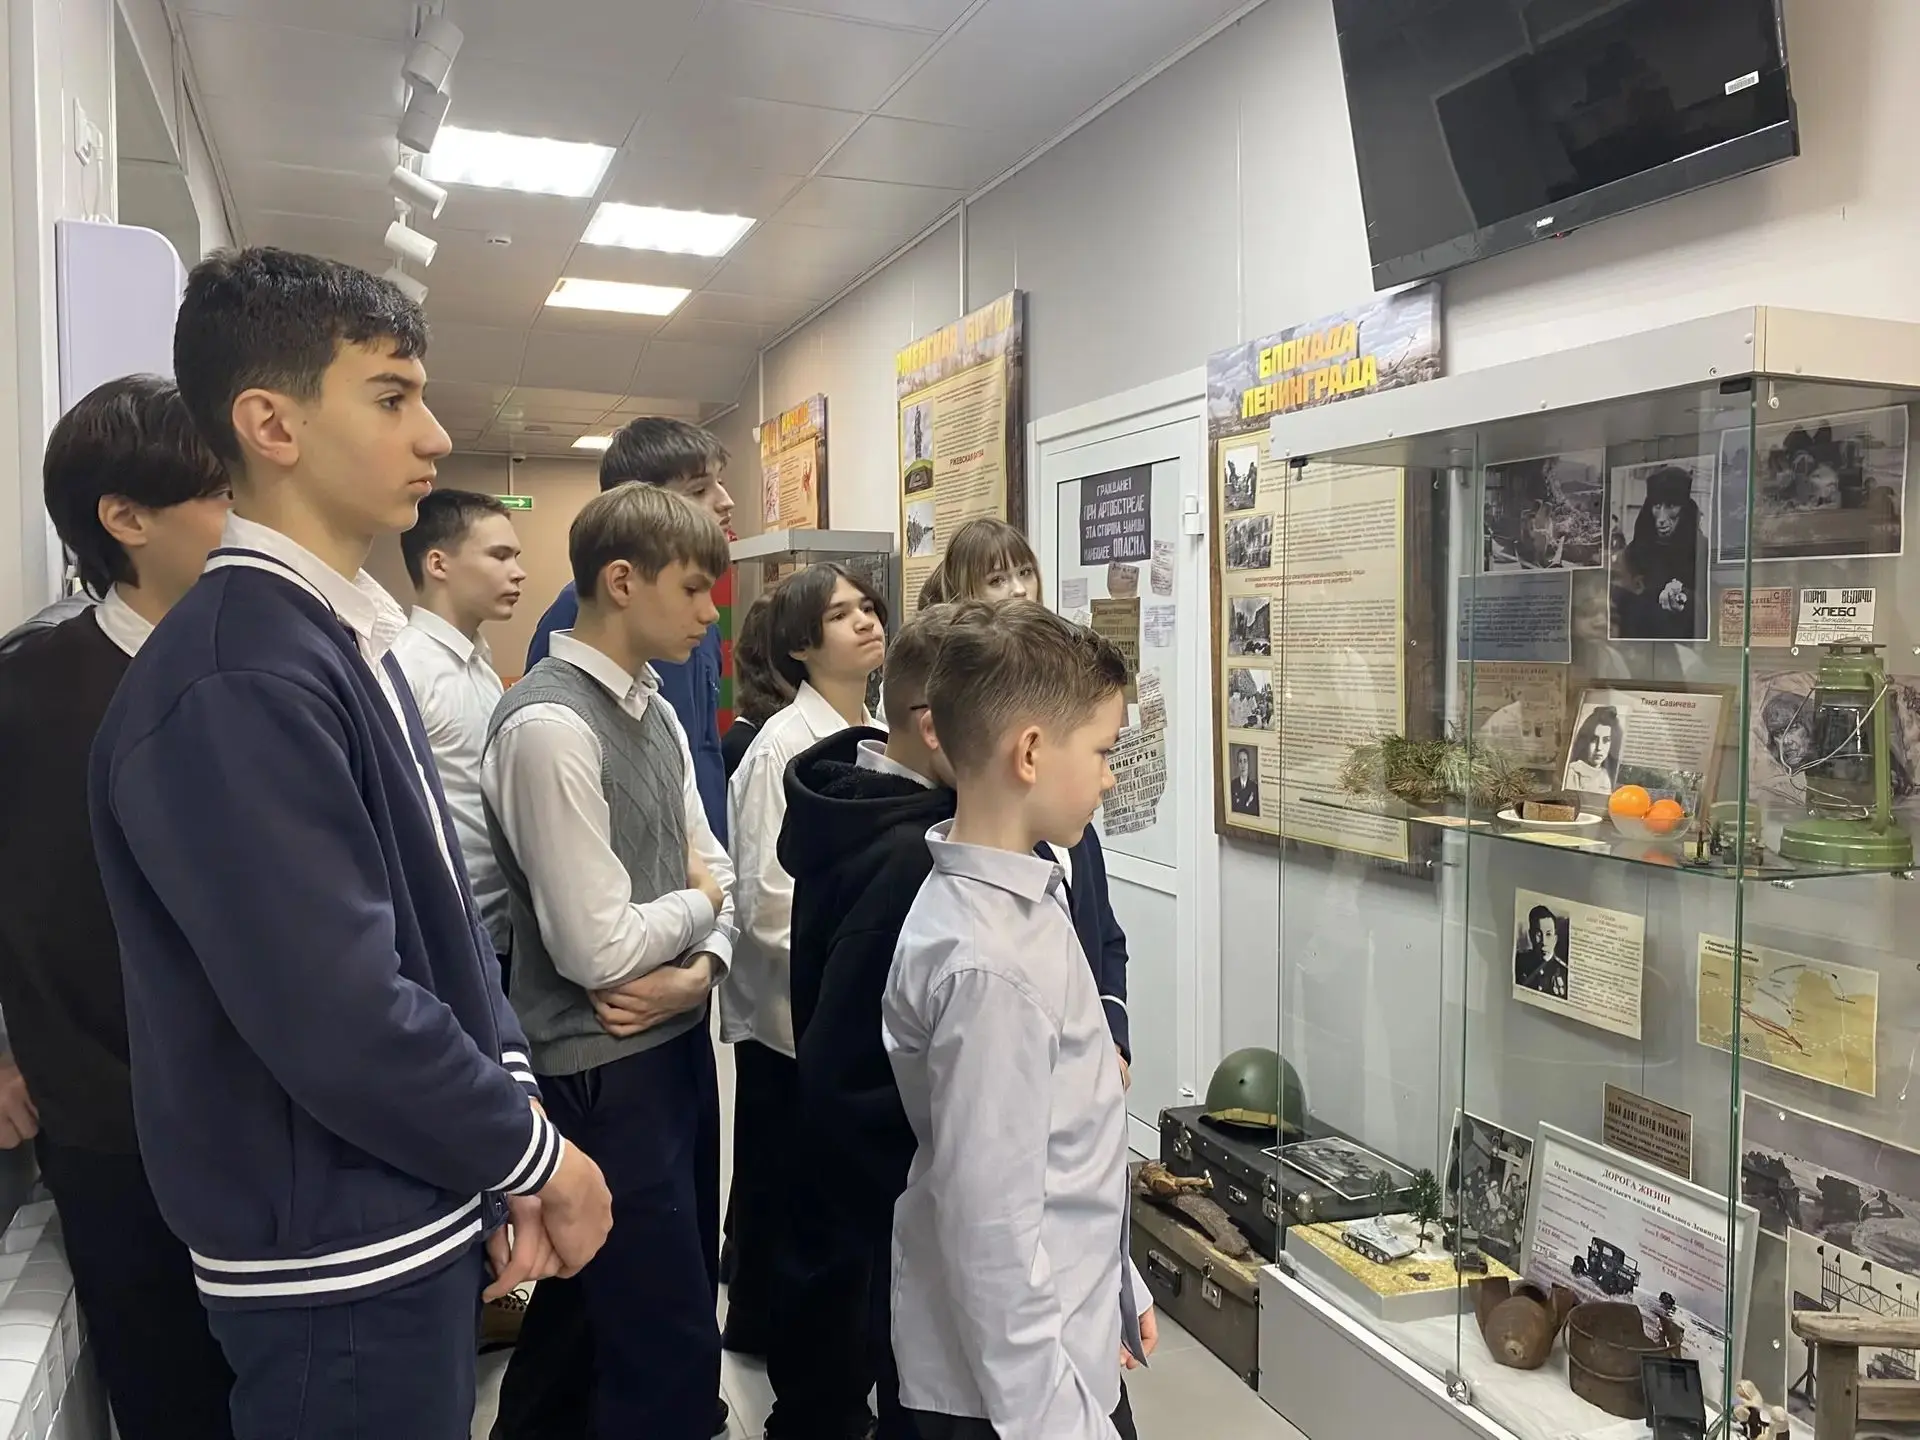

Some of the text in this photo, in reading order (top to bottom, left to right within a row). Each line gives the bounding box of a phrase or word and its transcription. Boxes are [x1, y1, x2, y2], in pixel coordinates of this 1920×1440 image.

[1258, 320, 1357, 379] БЛОКАДА
[1241, 355, 1378, 419] ЛЕНИНГРАДА
[1083, 494, 1145, 521] ПРИ АРТОБСТРЕЛЕ
[1085, 525, 1096, 539] ЭТА
[1112, 535, 1146, 558] ОПАСНА
[1803, 589, 1873, 604] НОРМА ВЫДАЧИ
[1640, 697, 1697, 709] Таня Савичева
[1109, 749, 1157, 772] ОНЦЕРТЫ
[1602, 1168, 1671, 1205] ДОРОГА ЖИЗНИ
[1656, 1206, 1691, 1226] блокадного
